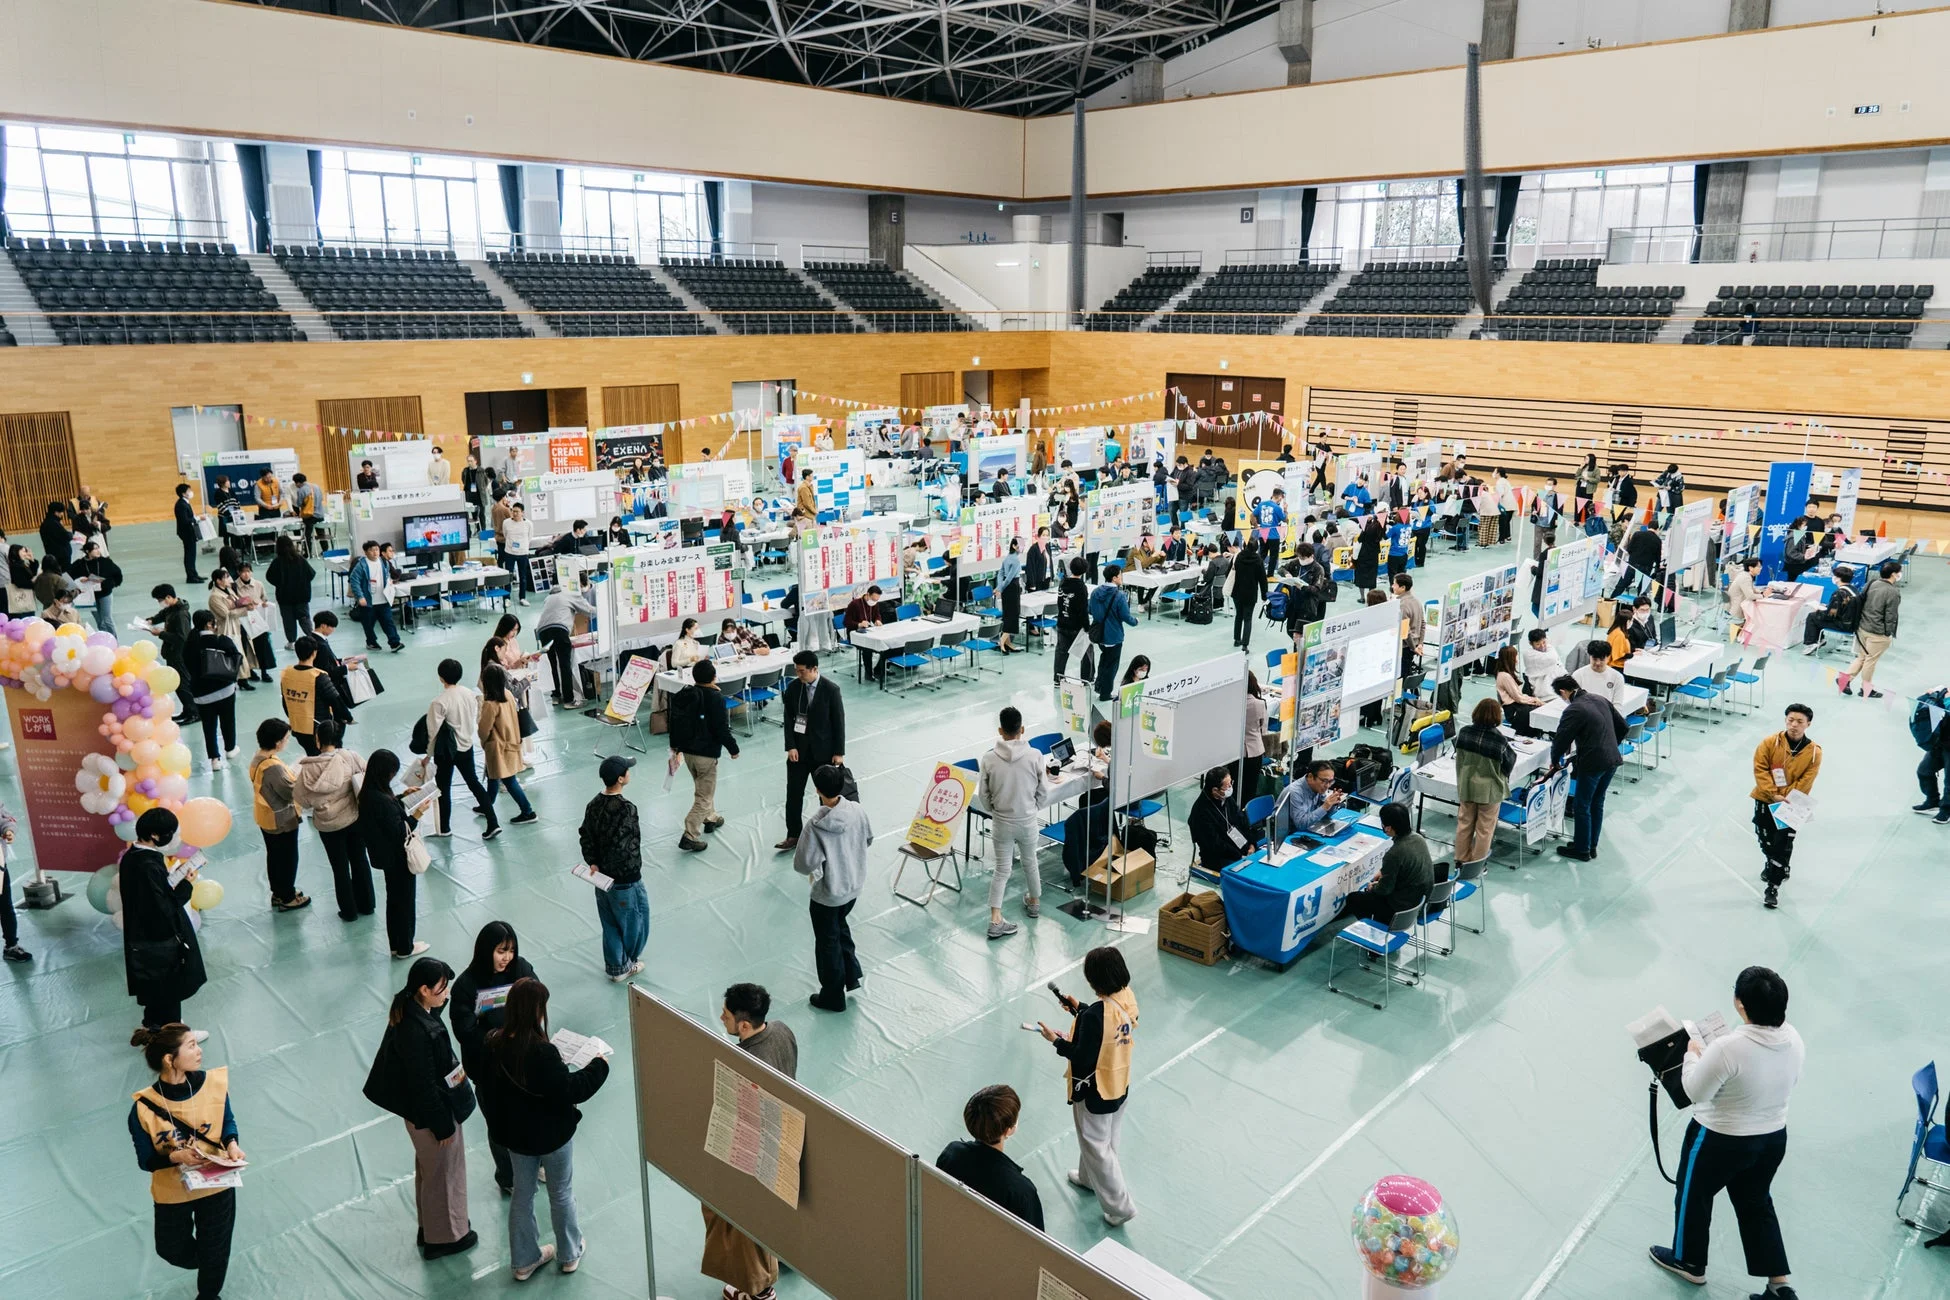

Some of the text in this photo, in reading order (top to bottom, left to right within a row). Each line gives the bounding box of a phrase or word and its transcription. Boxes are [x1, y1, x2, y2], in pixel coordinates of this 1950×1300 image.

[891, 212, 897, 222] E
[1243, 210, 1251, 220] D
[551, 446, 584, 457] CREATE
[552, 457, 569, 466] THE
[528, 481, 538, 489] 20
[807, 534, 814, 545] B
[640, 553, 701, 568] お楽しみ企業ブース
[1306, 627, 1320, 643] 43
[1325, 623, 1347, 635] 岡安ゴム
[1166, 675, 1201, 693] サンワコン
[22, 715, 50, 724] WORK
[25, 724, 53, 734] しが博
[937, 788, 959, 799] お楽しみ
